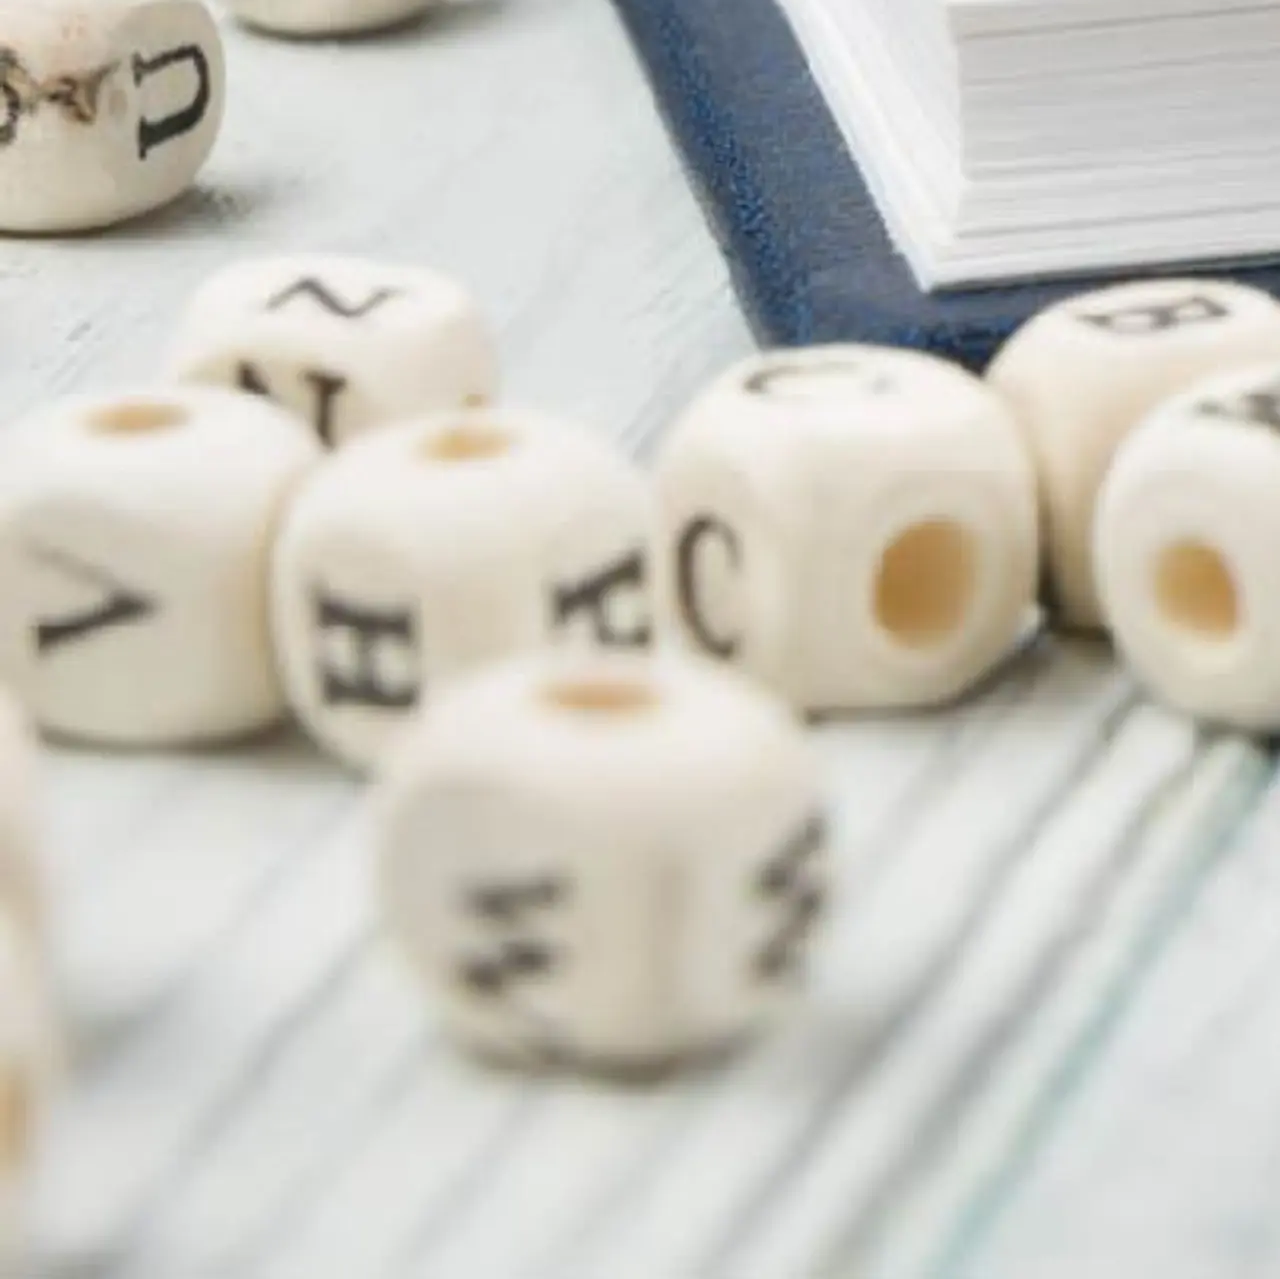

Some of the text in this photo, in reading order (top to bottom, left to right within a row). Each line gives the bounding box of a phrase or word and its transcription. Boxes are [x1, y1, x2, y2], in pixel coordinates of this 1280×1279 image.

[132, 43, 211, 160] U
[310, 582, 423, 710] H
[675, 513, 743, 662] C
